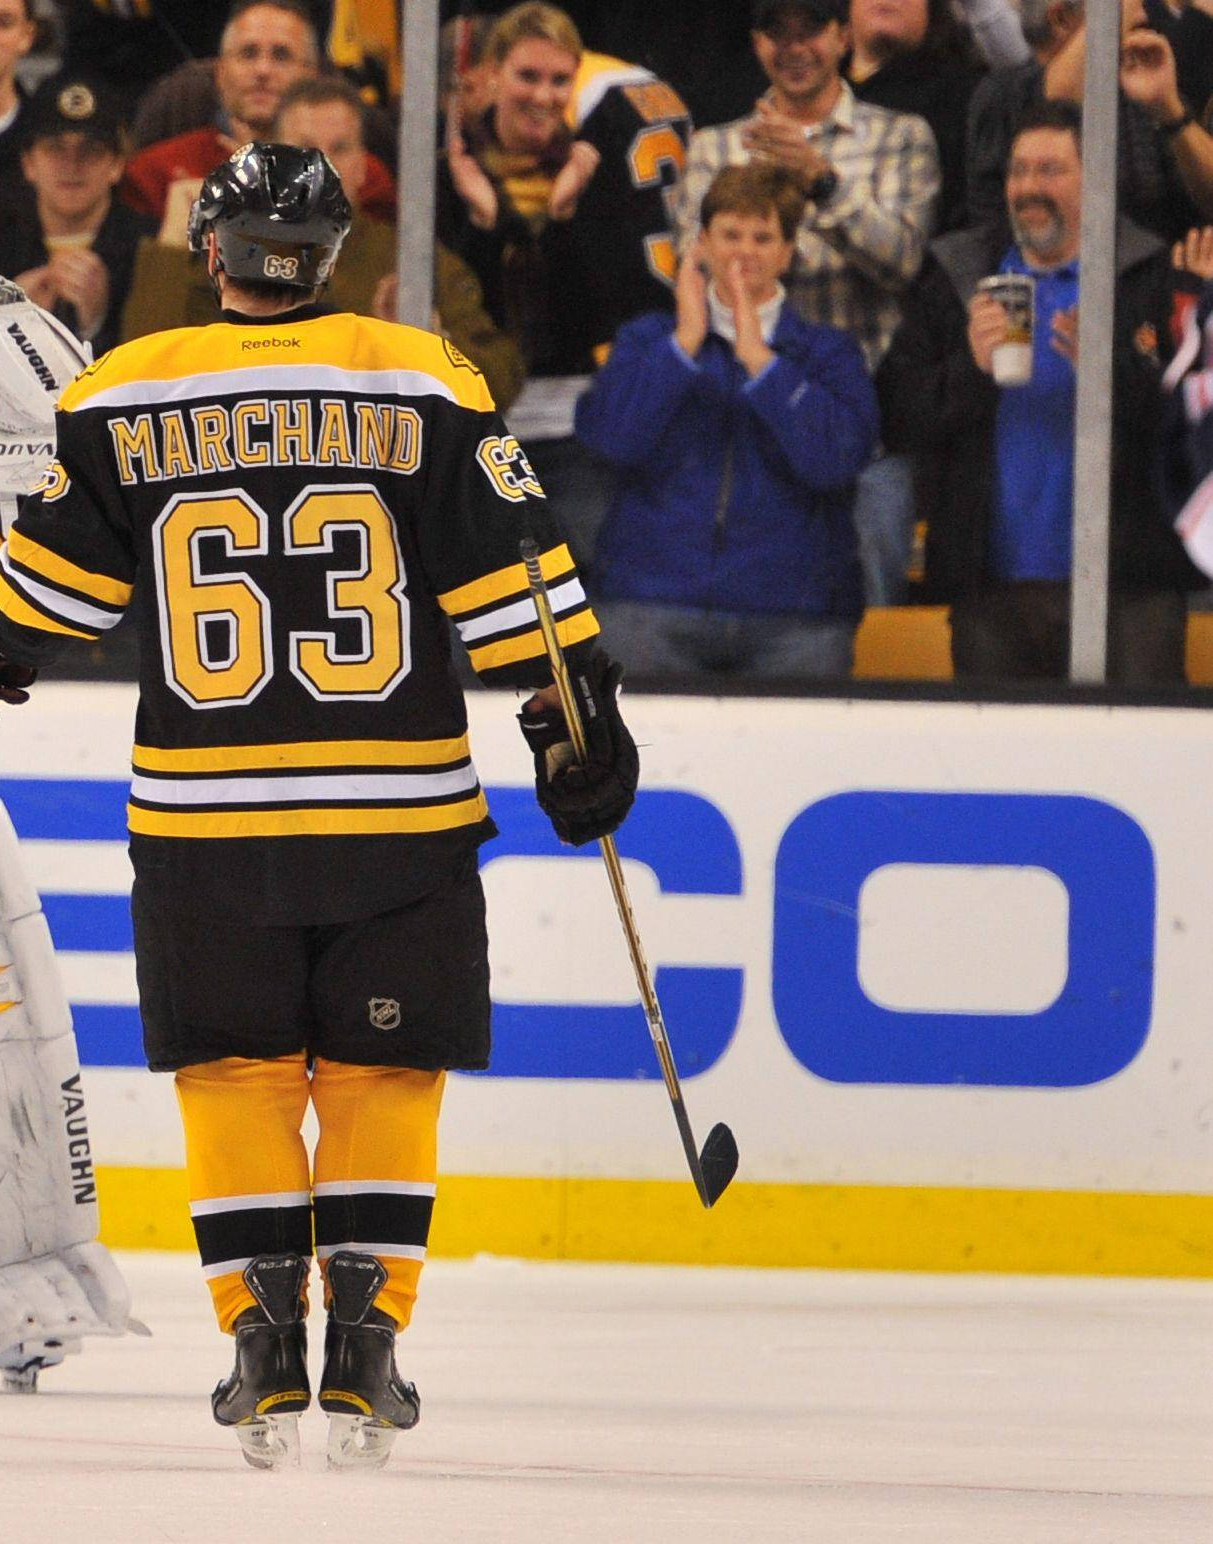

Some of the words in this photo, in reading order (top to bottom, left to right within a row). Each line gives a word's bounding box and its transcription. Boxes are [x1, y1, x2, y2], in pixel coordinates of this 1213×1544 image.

[263, 254, 299, 279] 63
[6, 322, 60, 392] VAUGHN
[241, 336, 301, 352] Reebok
[107, 398, 424, 486] MARCHAND
[151, 482, 413, 710] 63
[60, 1073, 97, 1205] VAUGHN
